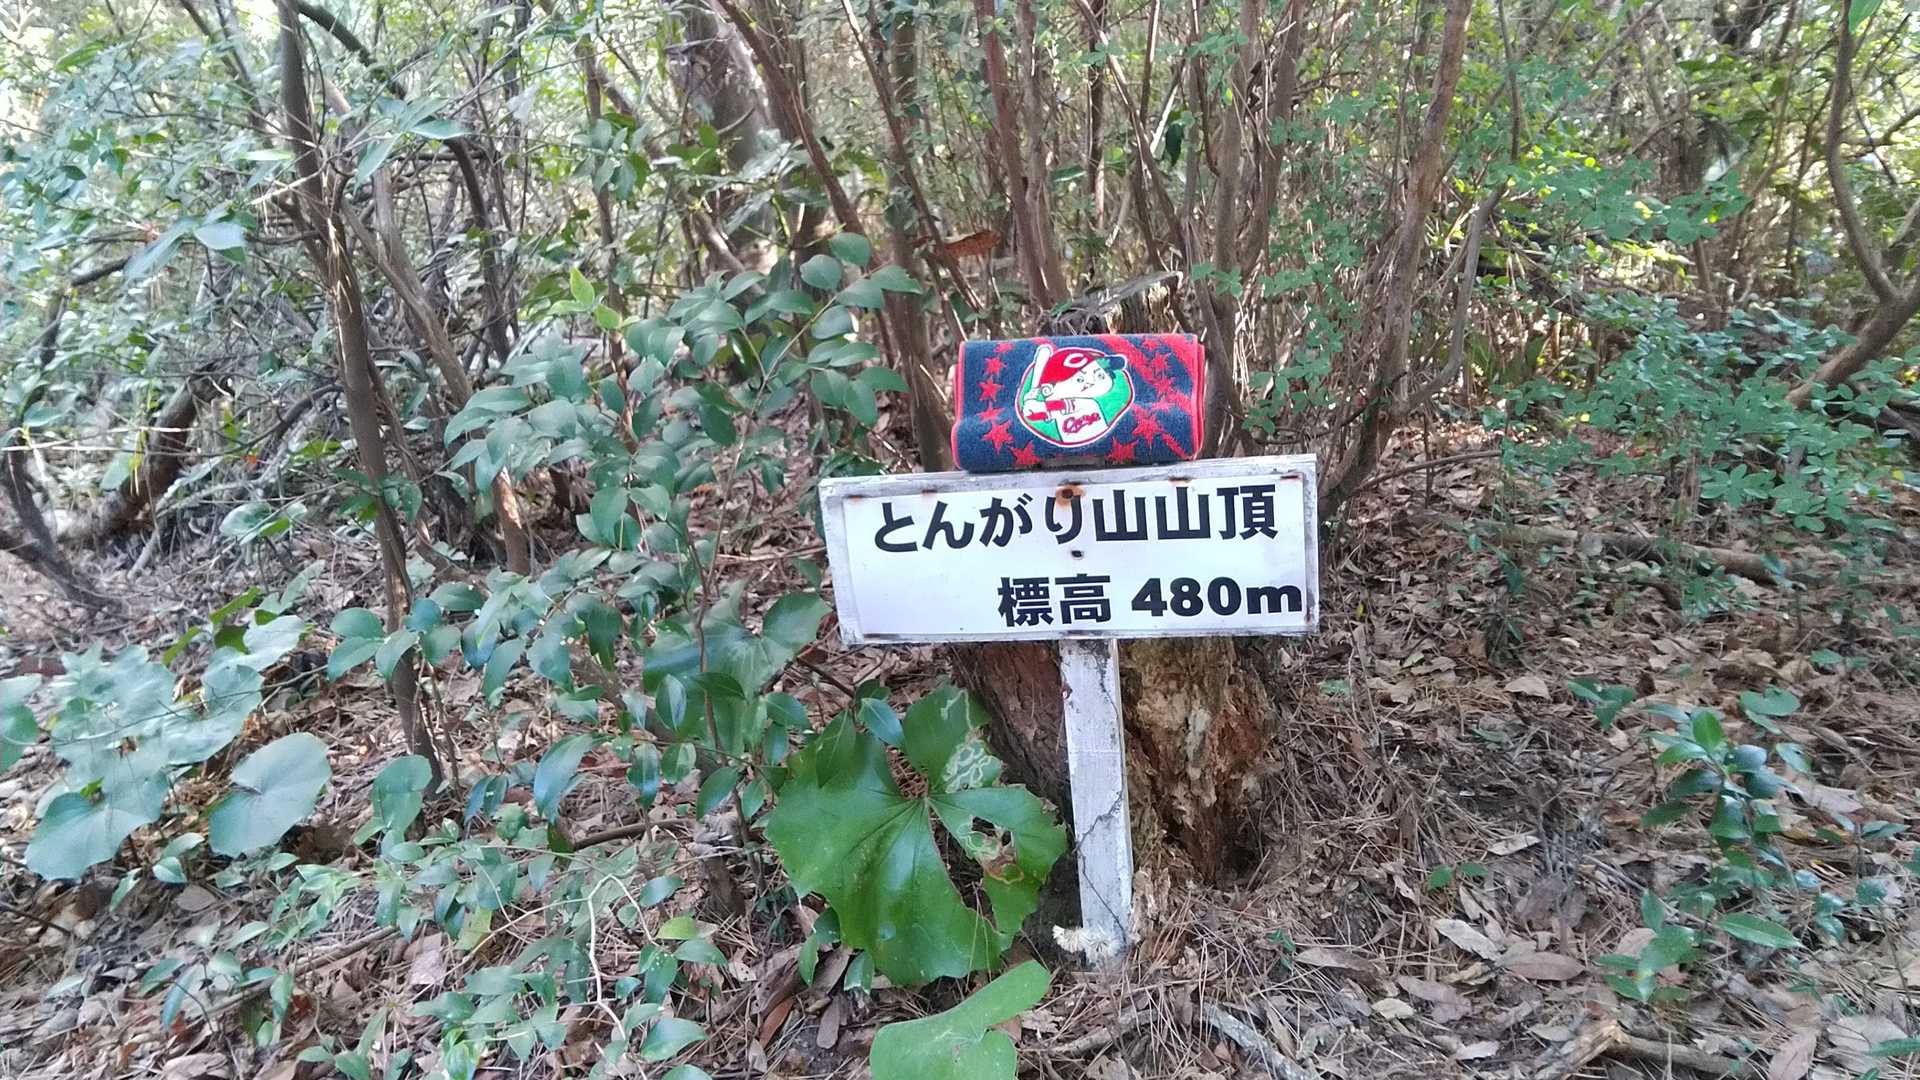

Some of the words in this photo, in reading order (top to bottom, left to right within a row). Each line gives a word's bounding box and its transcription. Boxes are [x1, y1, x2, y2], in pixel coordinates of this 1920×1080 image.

[1063, 353, 1088, 368] C
[875, 484, 1278, 552] とんがり山山頂
[997, 573, 1111, 626] 標高
[1131, 577, 1303, 617] 480m
